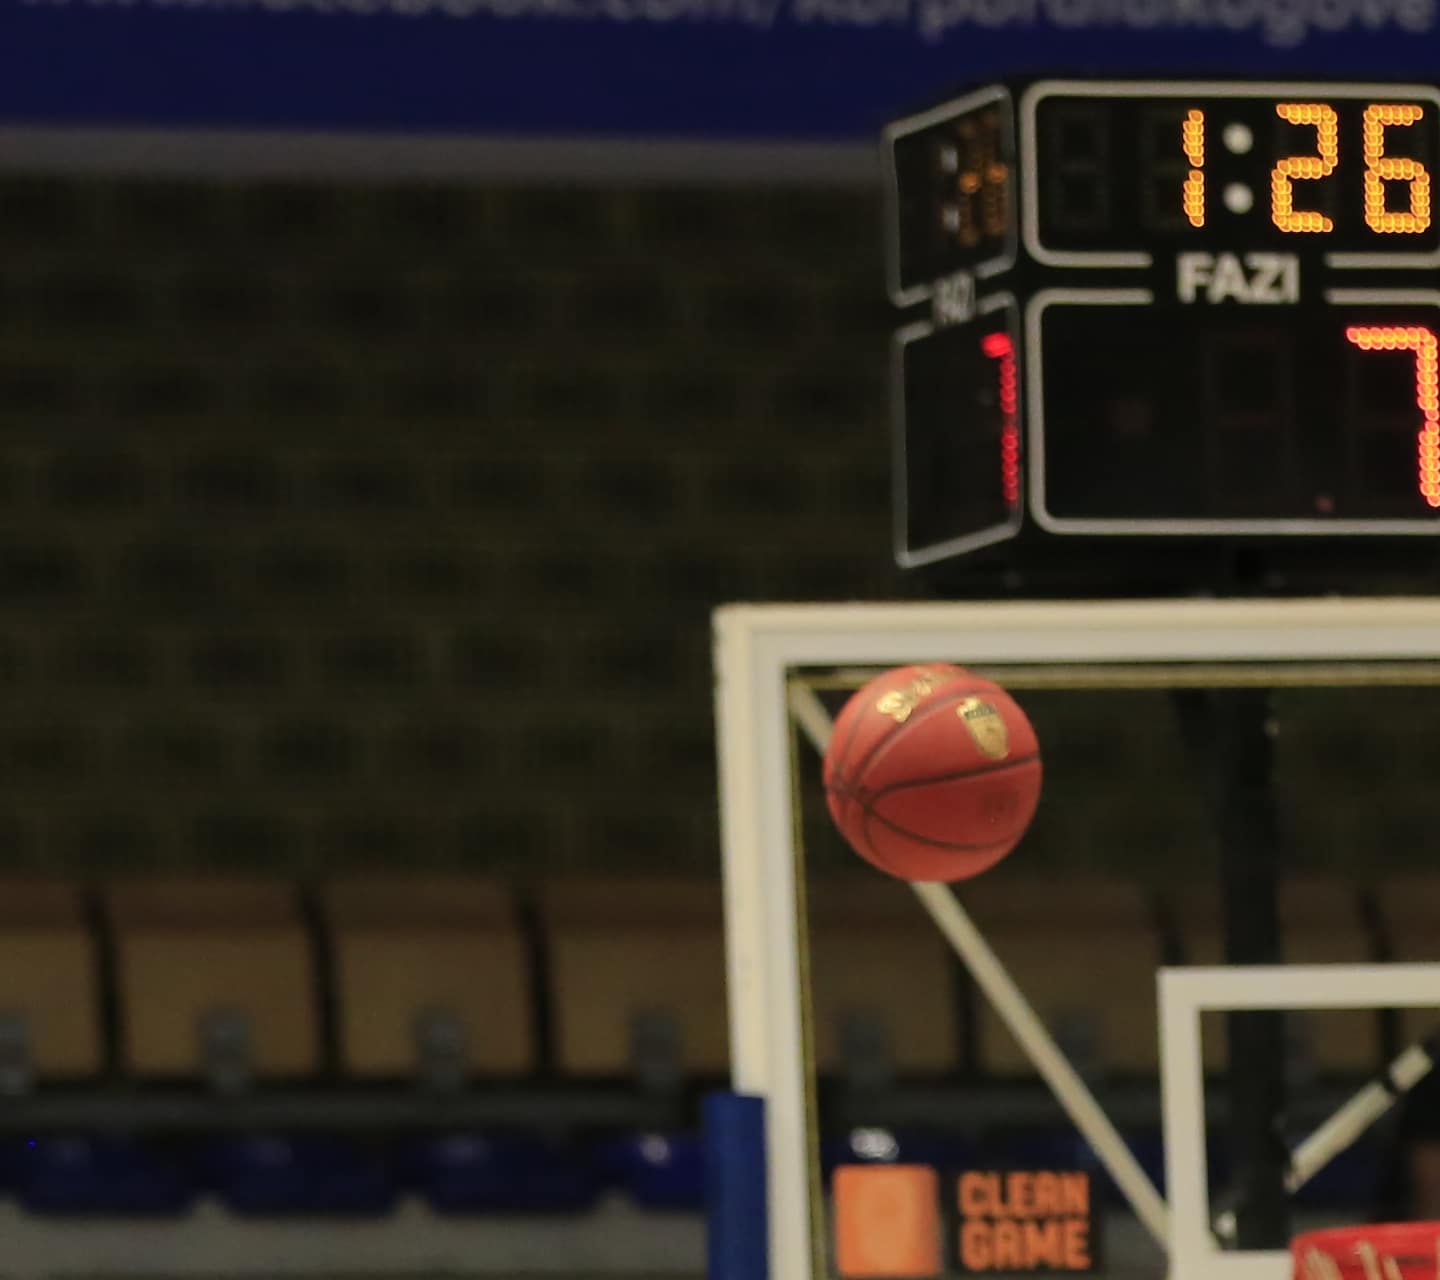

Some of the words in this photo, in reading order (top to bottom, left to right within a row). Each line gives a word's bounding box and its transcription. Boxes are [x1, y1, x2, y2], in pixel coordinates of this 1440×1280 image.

[1182, 103, 1431, 233] 1:26
[1176, 253, 1301, 304] FAZI
[959, 1169, 1091, 1217] CLEAN
[961, 1219, 1093, 1272] GAME
